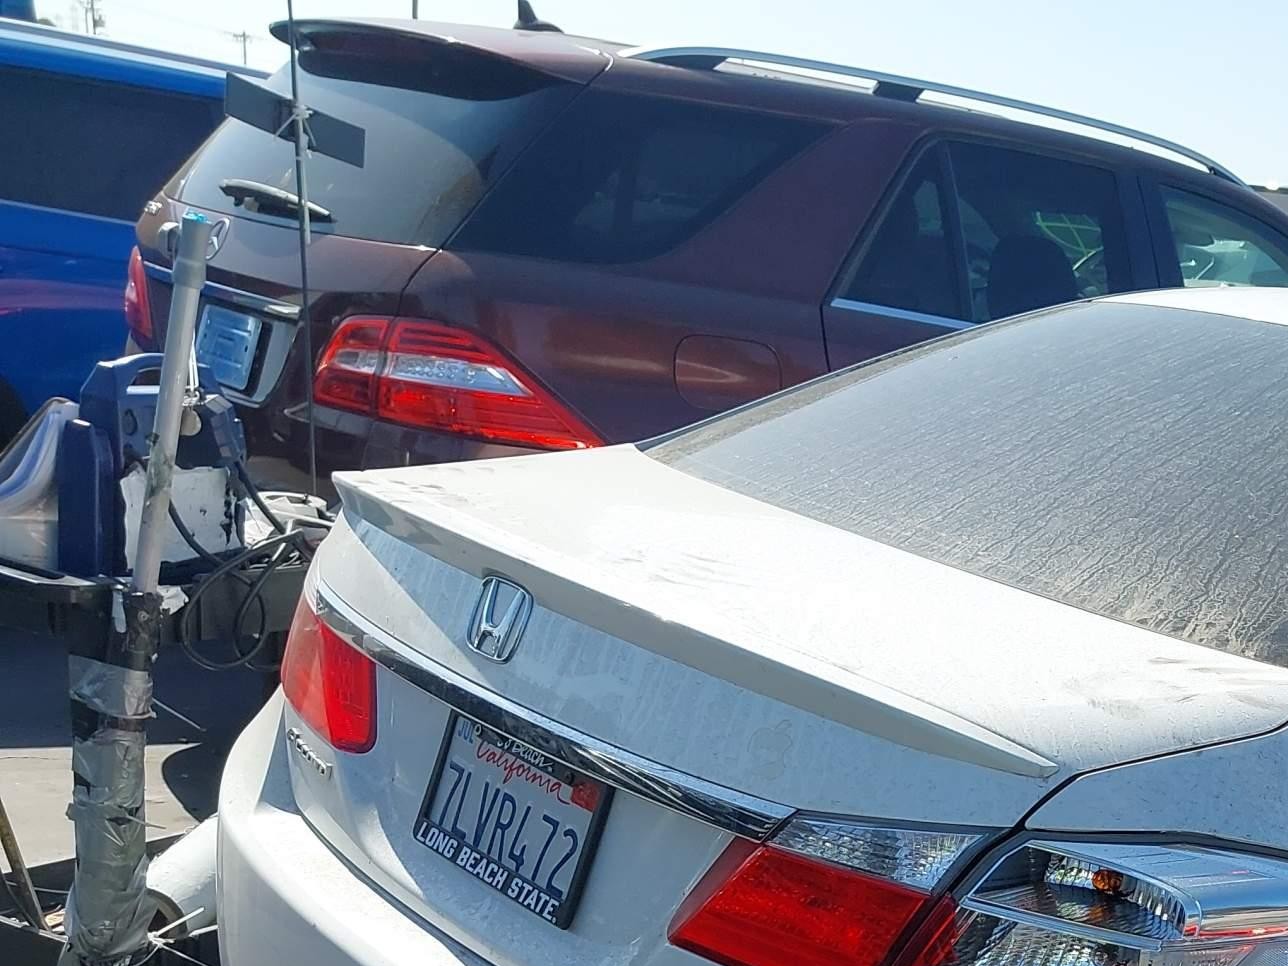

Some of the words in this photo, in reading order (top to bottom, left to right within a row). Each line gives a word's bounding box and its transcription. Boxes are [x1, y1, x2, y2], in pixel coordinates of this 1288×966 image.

[476, 739, 570, 806] California
[416, 821, 458, 859] LONG
[456, 845, 505, 891] BEACH
[438, 760, 579, 897] 7LVR472
